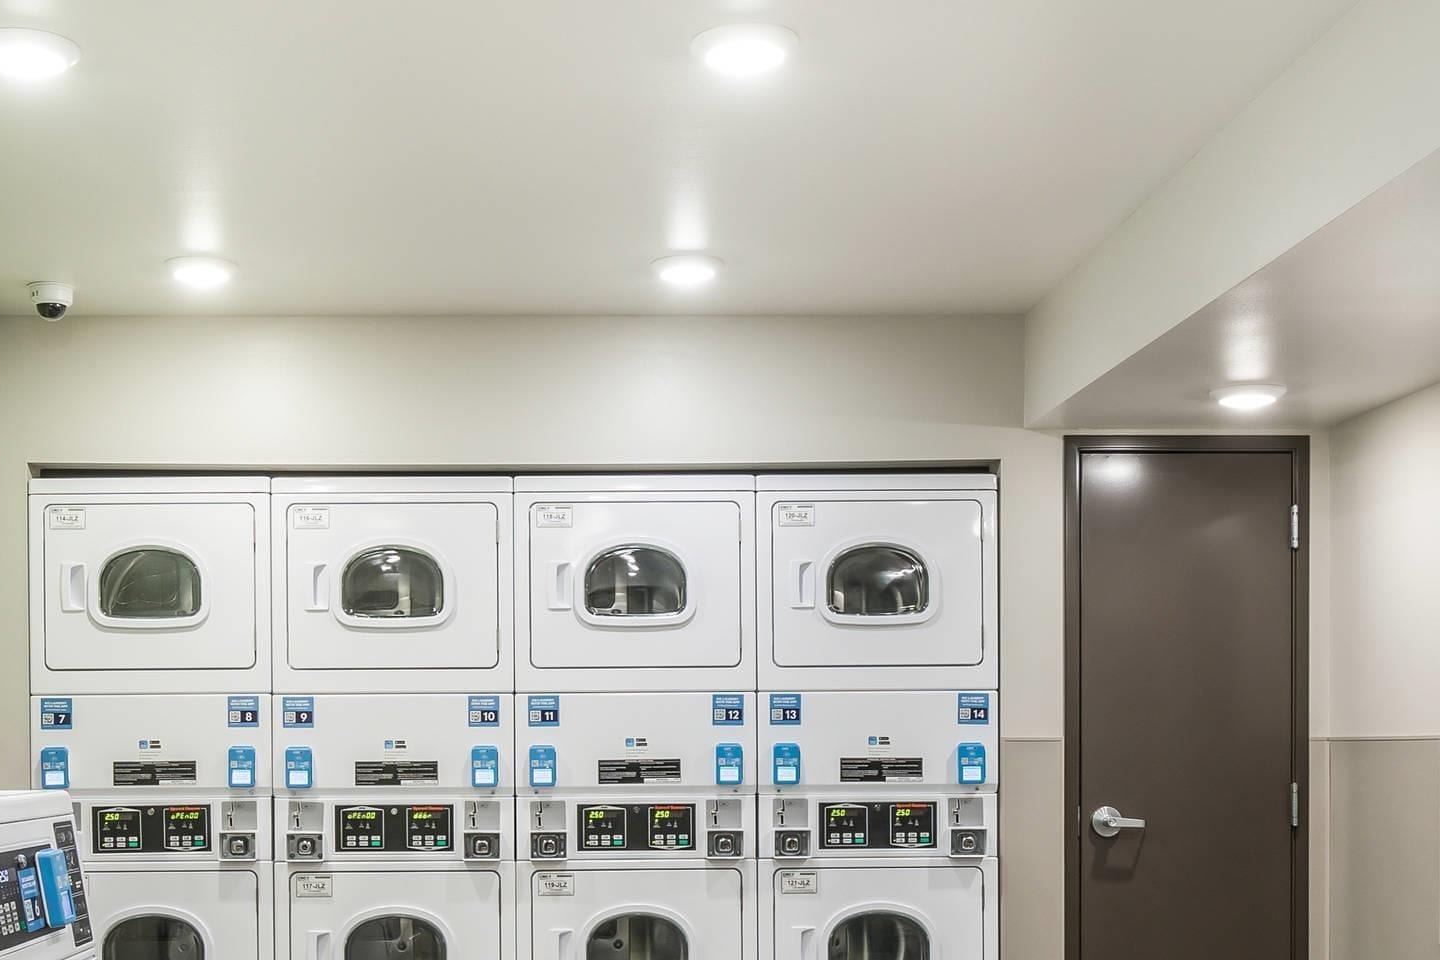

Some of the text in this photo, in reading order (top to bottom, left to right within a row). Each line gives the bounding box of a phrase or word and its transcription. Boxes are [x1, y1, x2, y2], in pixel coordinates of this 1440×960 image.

[58, 714, 66, 724] 7
[245, 711, 253, 721] 8
[299, 712, 308, 722] 9
[482, 711, 496, 721] 10
[544, 711, 554, 721] 11
[727, 710, 739, 720] 12
[784, 709, 797, 720] 13
[973, 709, 985, 719] 14
[34, 899, 41, 917] 6
